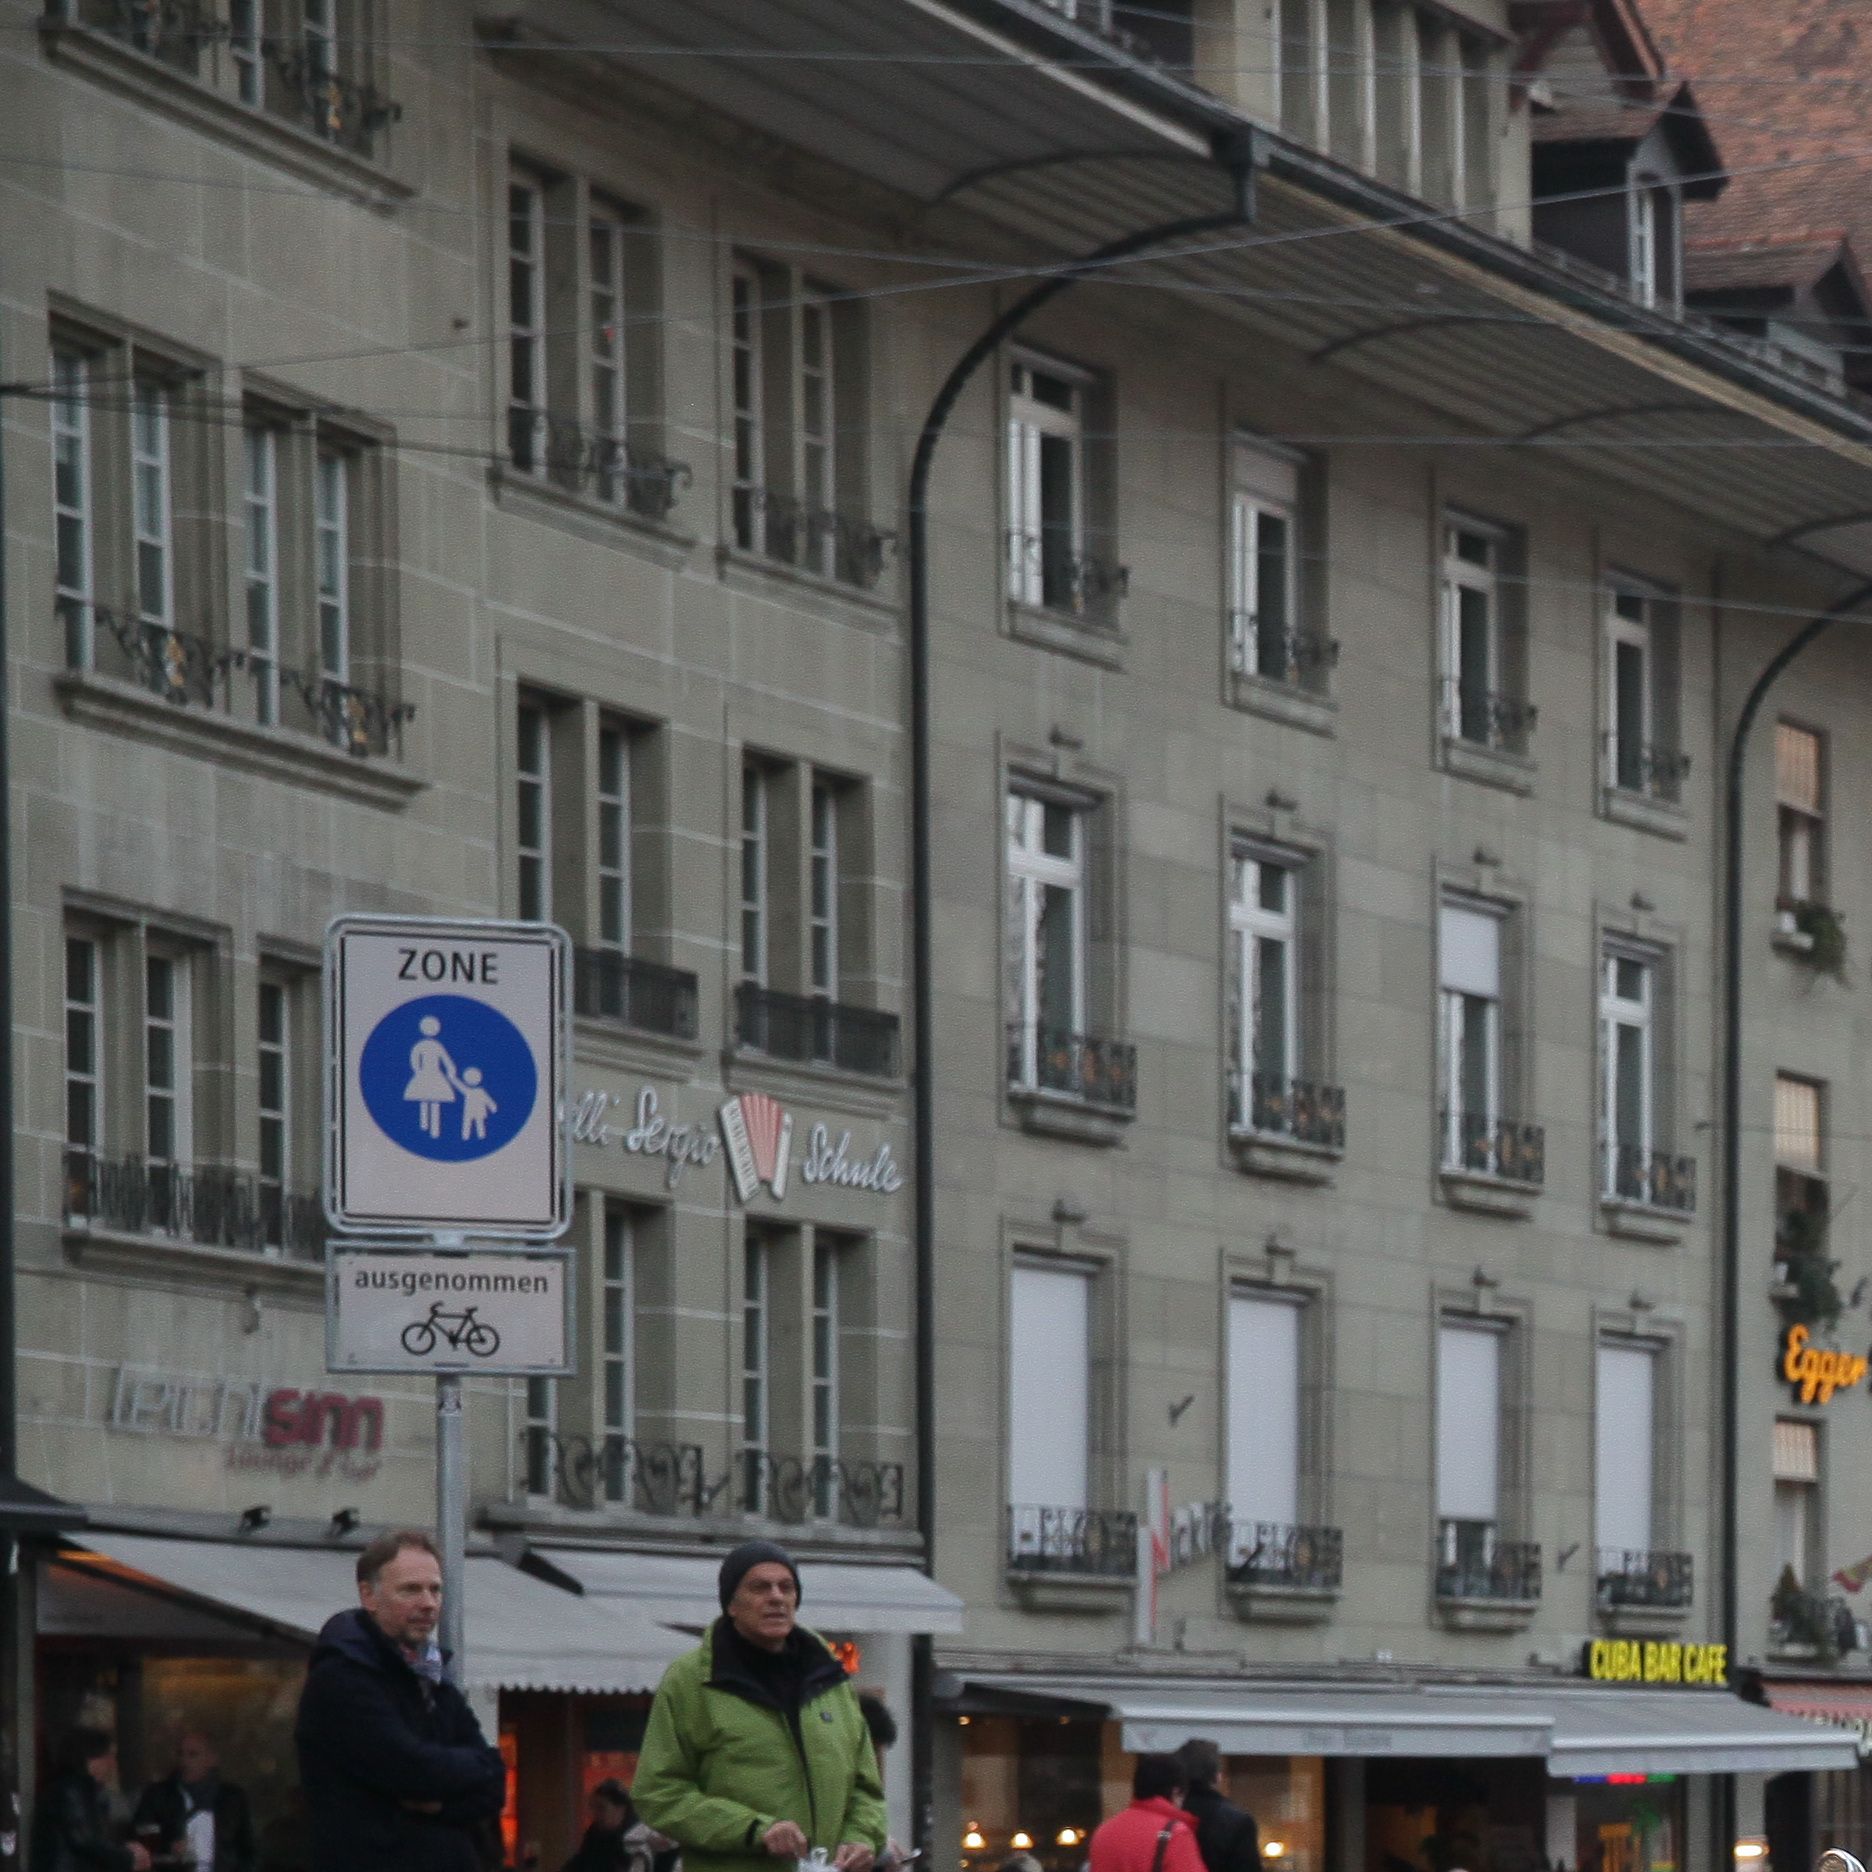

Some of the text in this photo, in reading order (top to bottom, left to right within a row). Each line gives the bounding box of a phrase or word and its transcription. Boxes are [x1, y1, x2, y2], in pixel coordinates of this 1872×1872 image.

[397, 949, 499, 985] ZONE
[625, 1086, 721, 1190] Sergio
[803, 1121, 903, 1193] Schule
[354, 1269, 549, 1296] ausgenommen
[1784, 1323, 1869, 1405] Egger
[1590, 1638, 1642, 1681] CUBA
[1644, 1640, 1681, 1683] BAR
